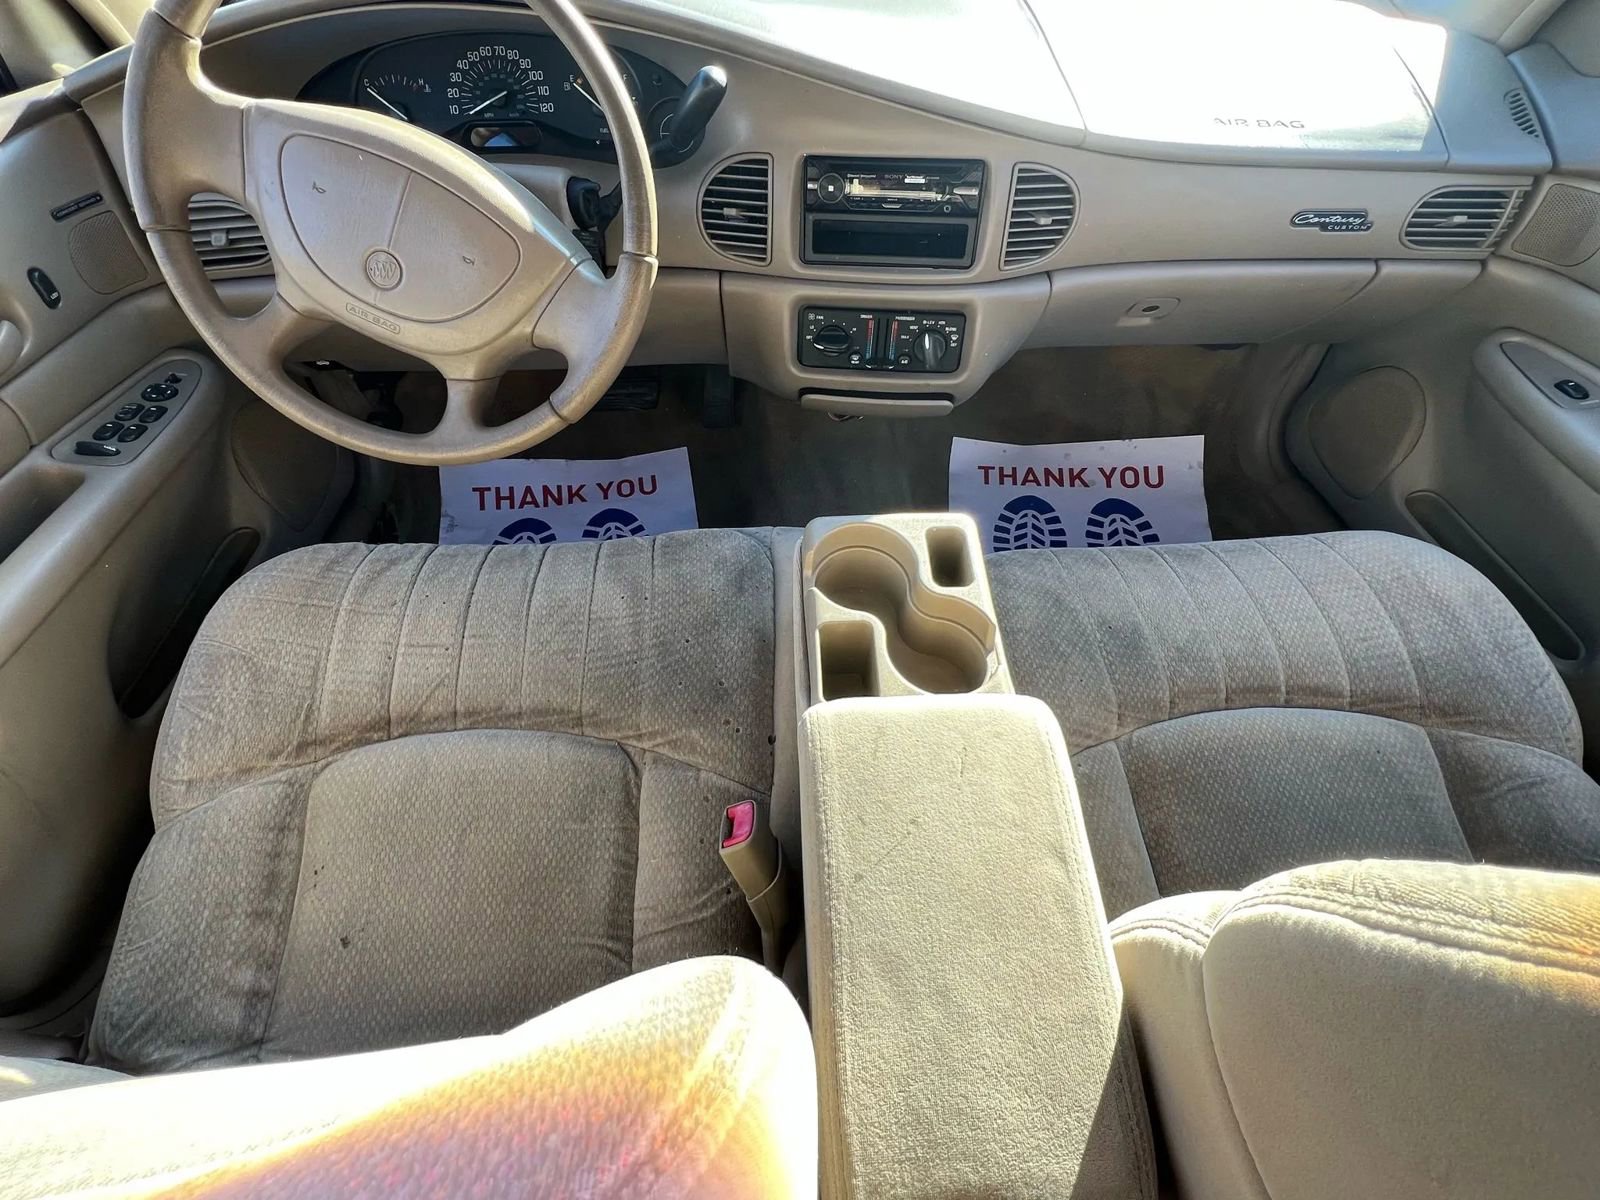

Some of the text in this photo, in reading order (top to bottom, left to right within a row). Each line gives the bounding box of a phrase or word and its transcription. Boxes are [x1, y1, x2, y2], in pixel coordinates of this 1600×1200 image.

[467, 51, 480, 61] 50
[480, 47, 492, 56] 60
[493, 46, 506, 56] 70
[507, 50, 519, 60] 80
[456, 59, 469, 69] 40
[519, 59, 531, 69] 90
[449, 72, 462, 82] 30
[528, 71, 543, 80] 100
[447, 88, 460, 98] 20
[537, 86, 550, 96] 110
[449, 105, 459, 115] 10
[539, 103, 554, 112] 120
[1213, 117, 1305, 129] AIR BAG
[1295, 214, 1366, 225] Century
[349, 306, 397, 331] AIR BAG
[977, 465, 1165, 489] THANK YOU
[472, 474, 658, 512] THANK YOU
